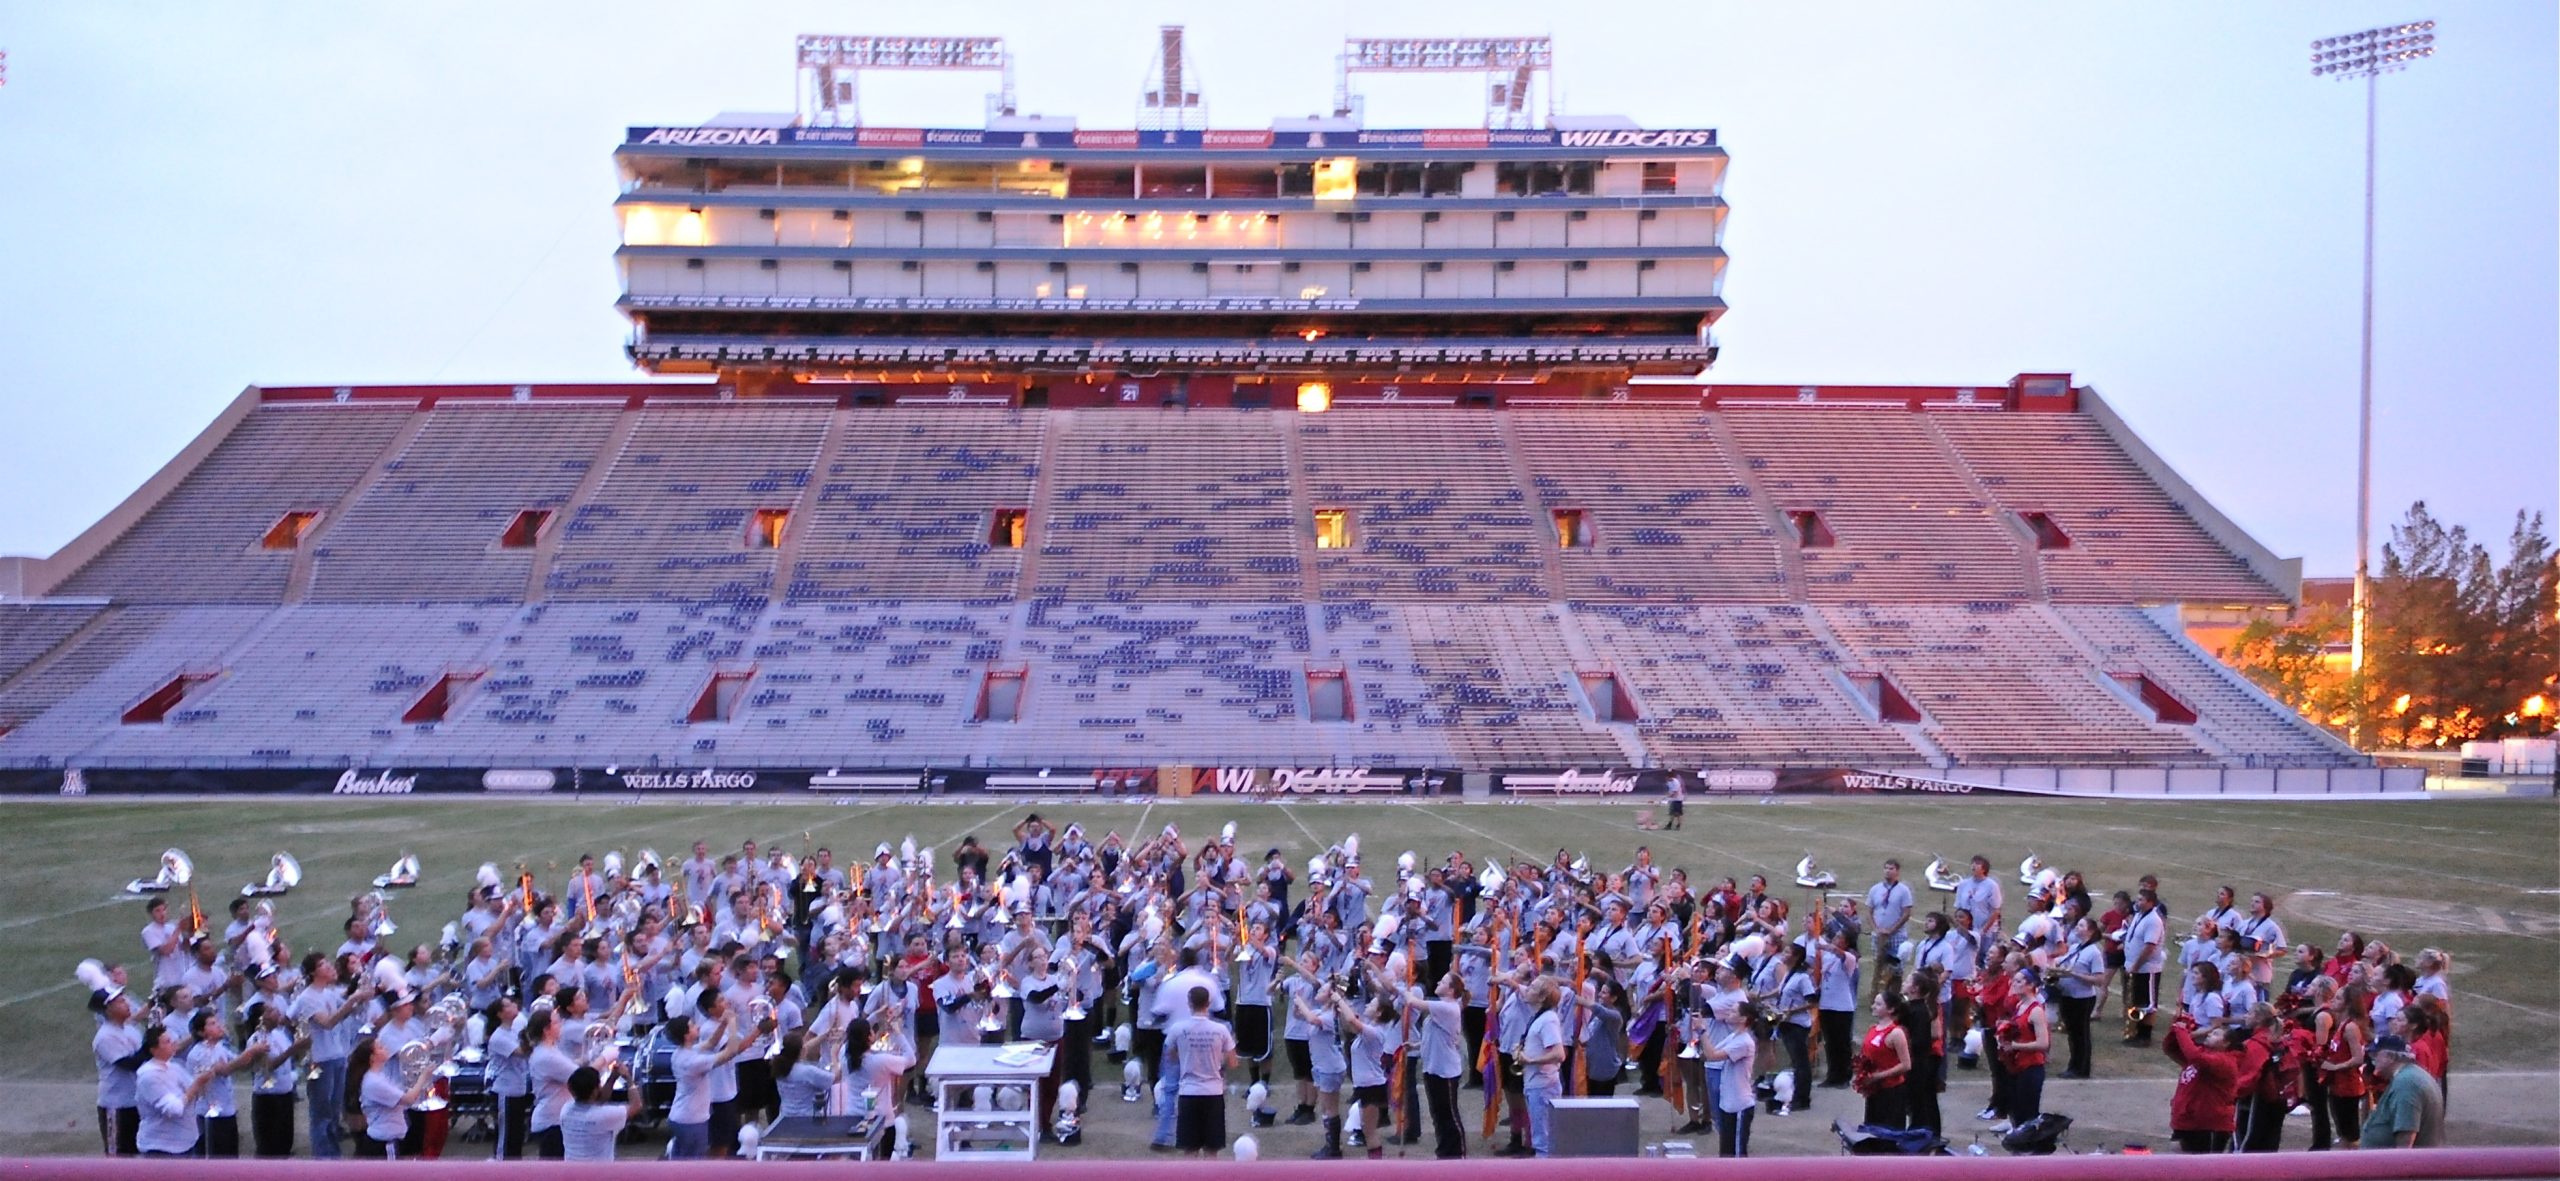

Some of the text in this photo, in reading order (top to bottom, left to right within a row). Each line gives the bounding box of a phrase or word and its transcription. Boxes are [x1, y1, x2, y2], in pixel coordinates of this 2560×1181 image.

[641, 128, 779, 145] ARIZONA
[1560, 130, 1709, 147] WILDCATS
[949, 391, 964, 400] 20
[1123, 389, 1137, 400] 21
[1383, 391, 1399, 401] 22
[1613, 391, 1628, 401] 23
[622, 773, 755, 788] WELLS FARGO
[1842, 775, 1906, 790] WELLS
